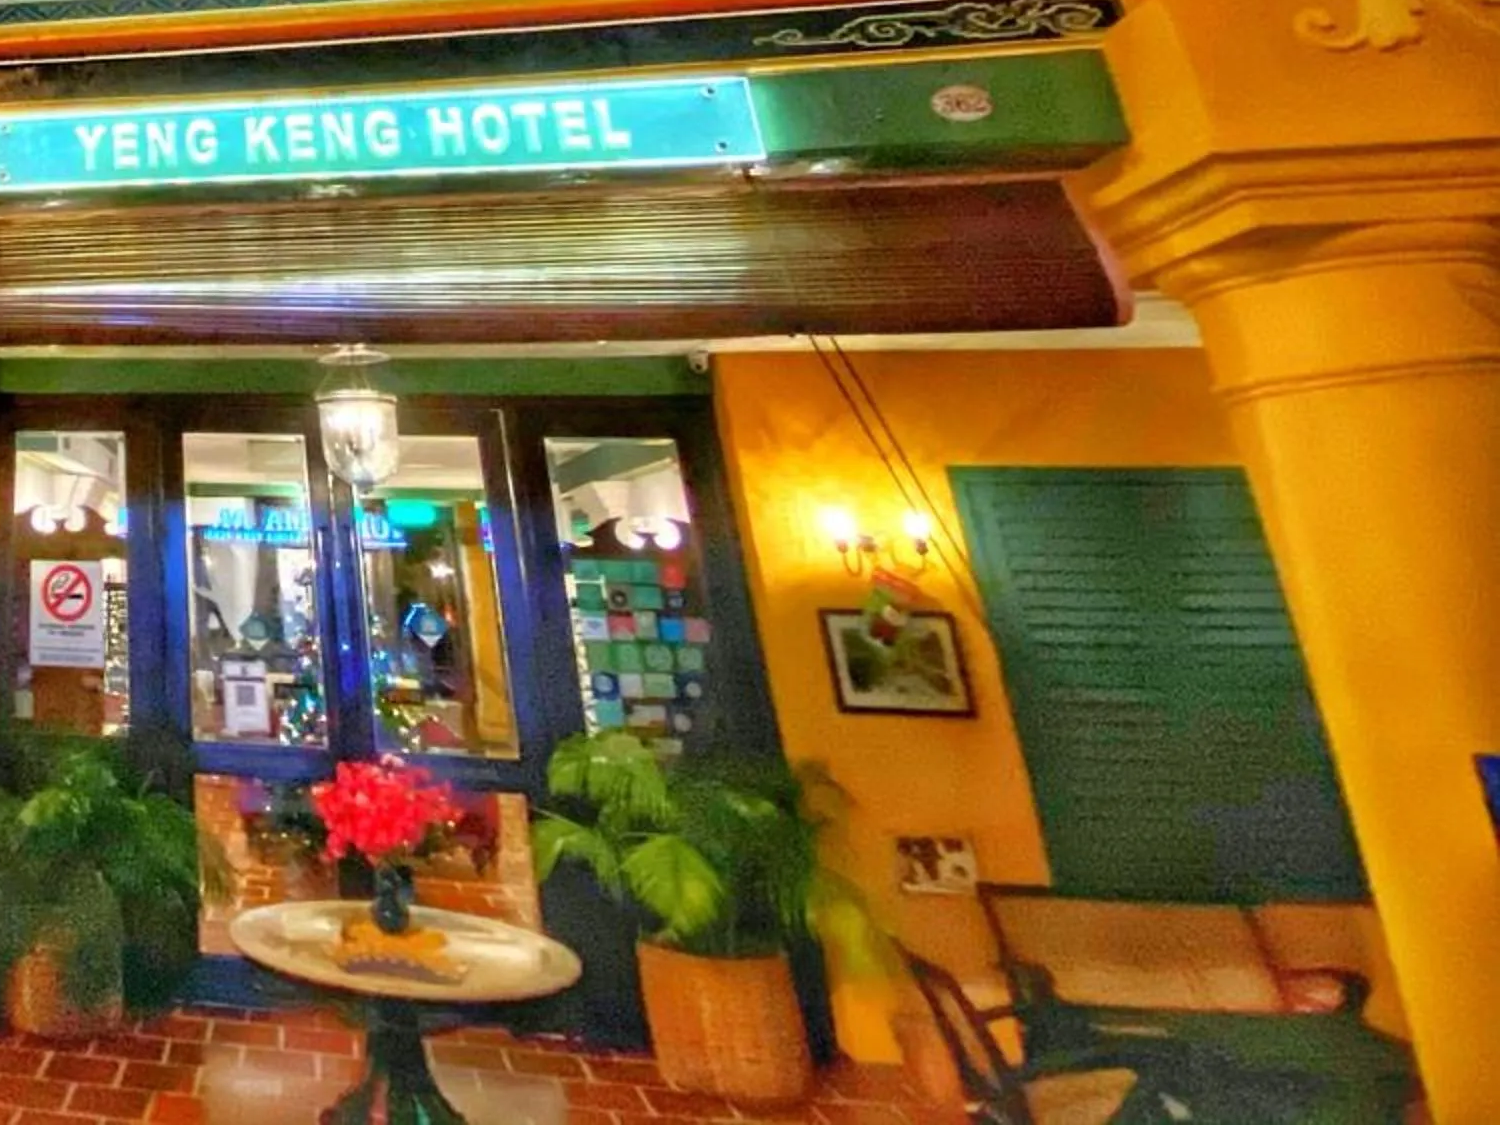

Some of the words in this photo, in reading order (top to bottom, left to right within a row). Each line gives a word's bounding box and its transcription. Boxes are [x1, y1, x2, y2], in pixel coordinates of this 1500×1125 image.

[74, 118, 219, 172] YENG
[243, 108, 400, 163] KENG
[426, 98, 633, 157] HOTEL
